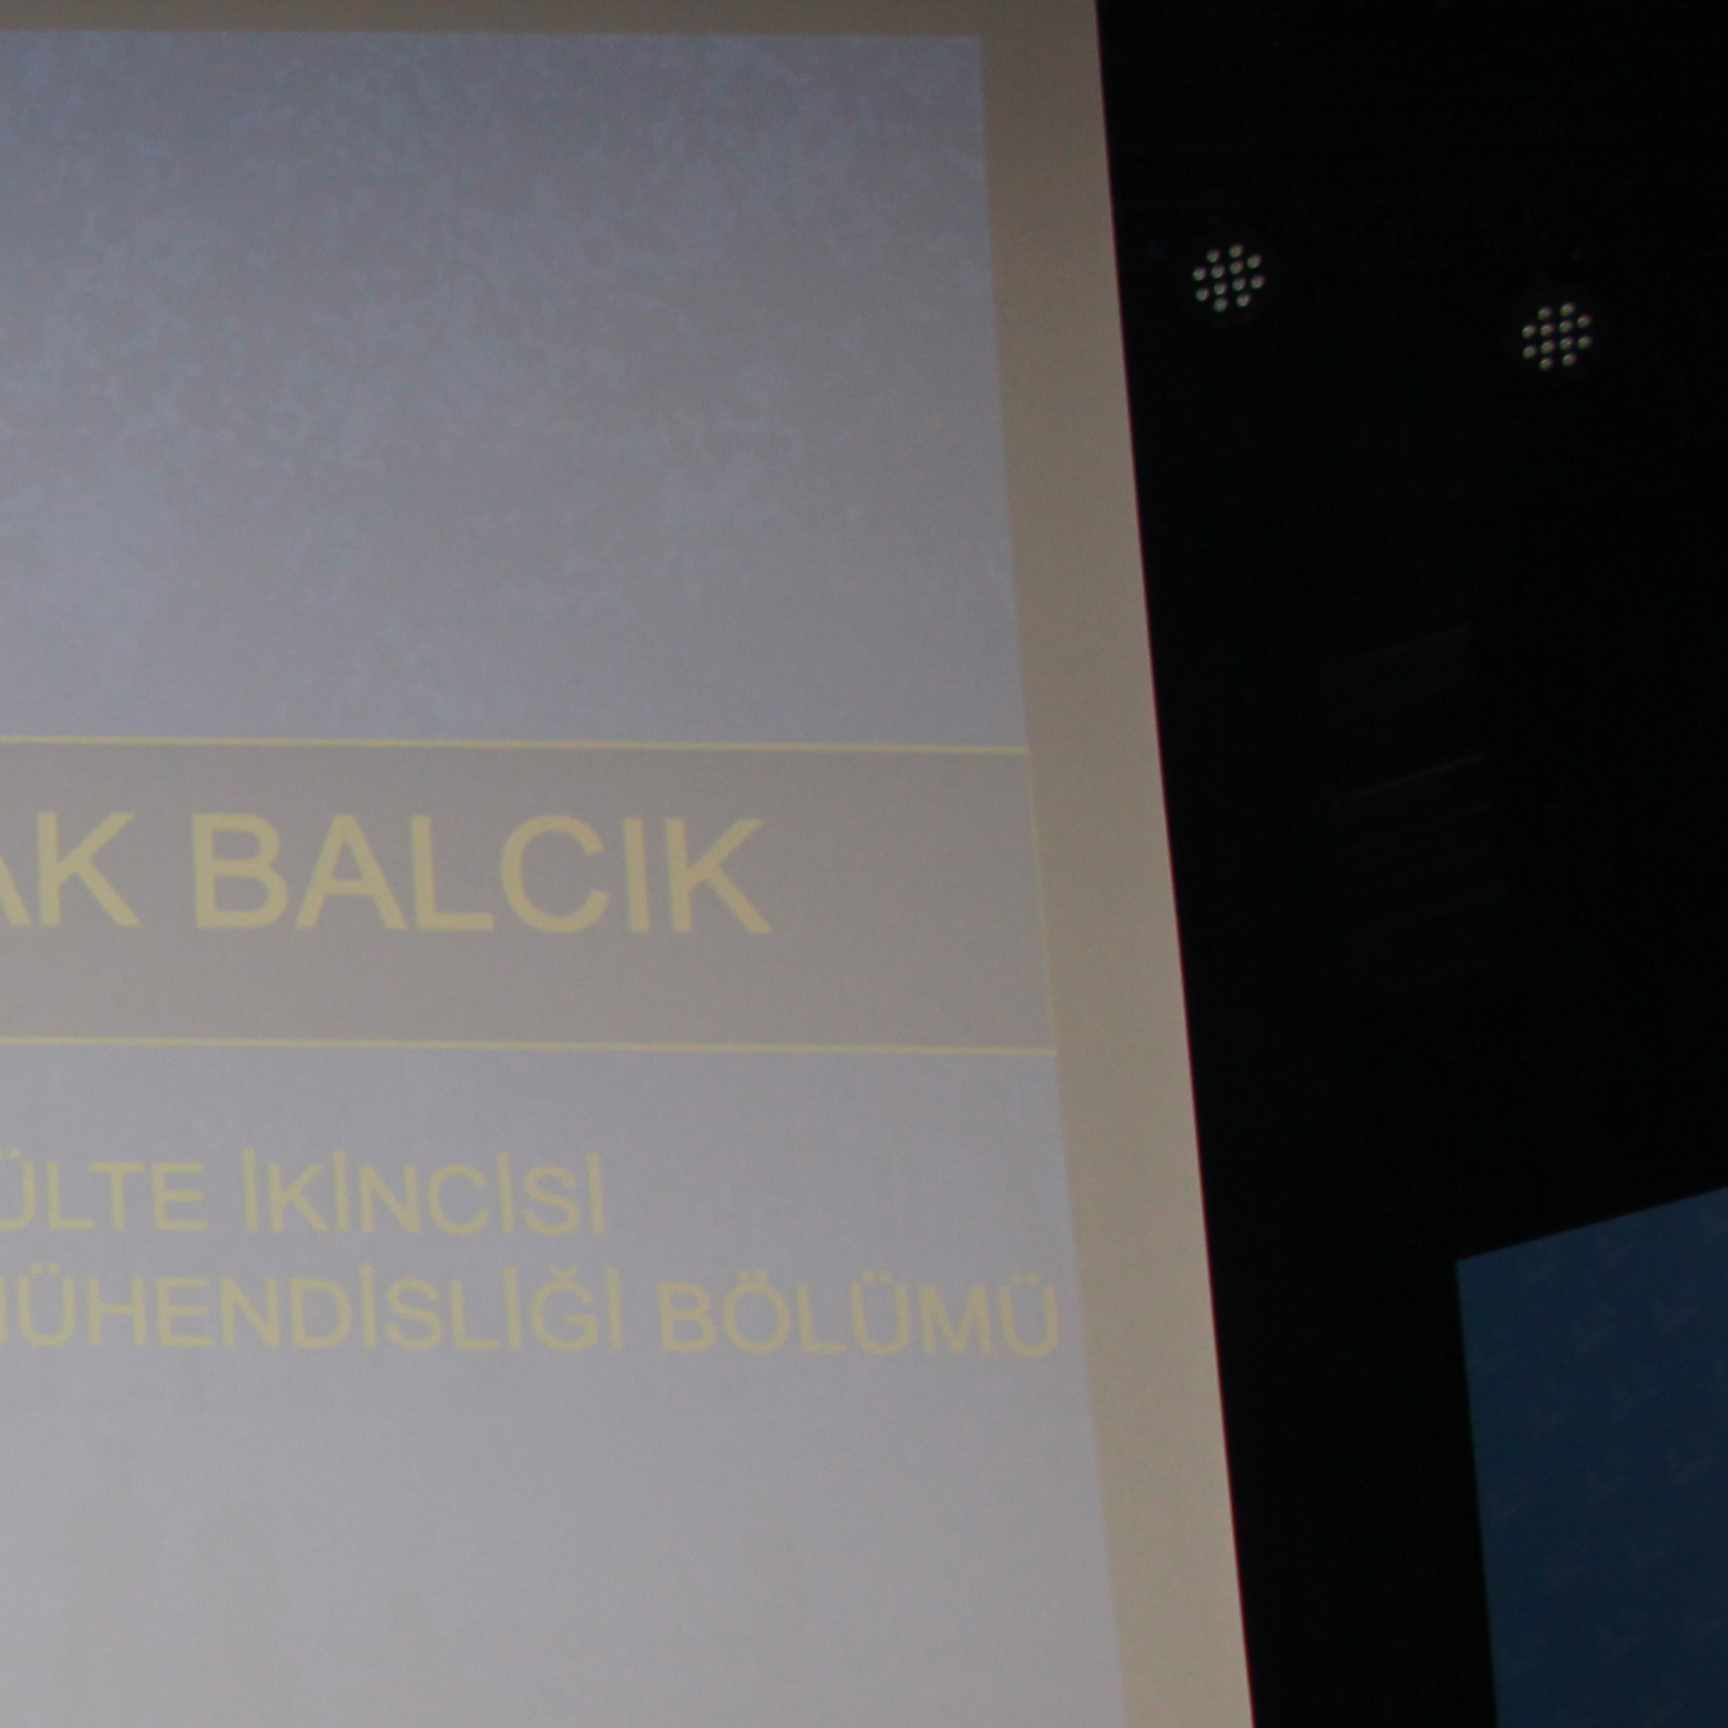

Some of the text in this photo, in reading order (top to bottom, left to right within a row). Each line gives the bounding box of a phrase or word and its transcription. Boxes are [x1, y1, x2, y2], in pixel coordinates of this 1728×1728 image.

[191, 812, 773, 934] BALCIK
[241, 1147, 606, 1236] İKİNCİSİ
[658, 1269, 1060, 1358] BÖLÜMÜ
